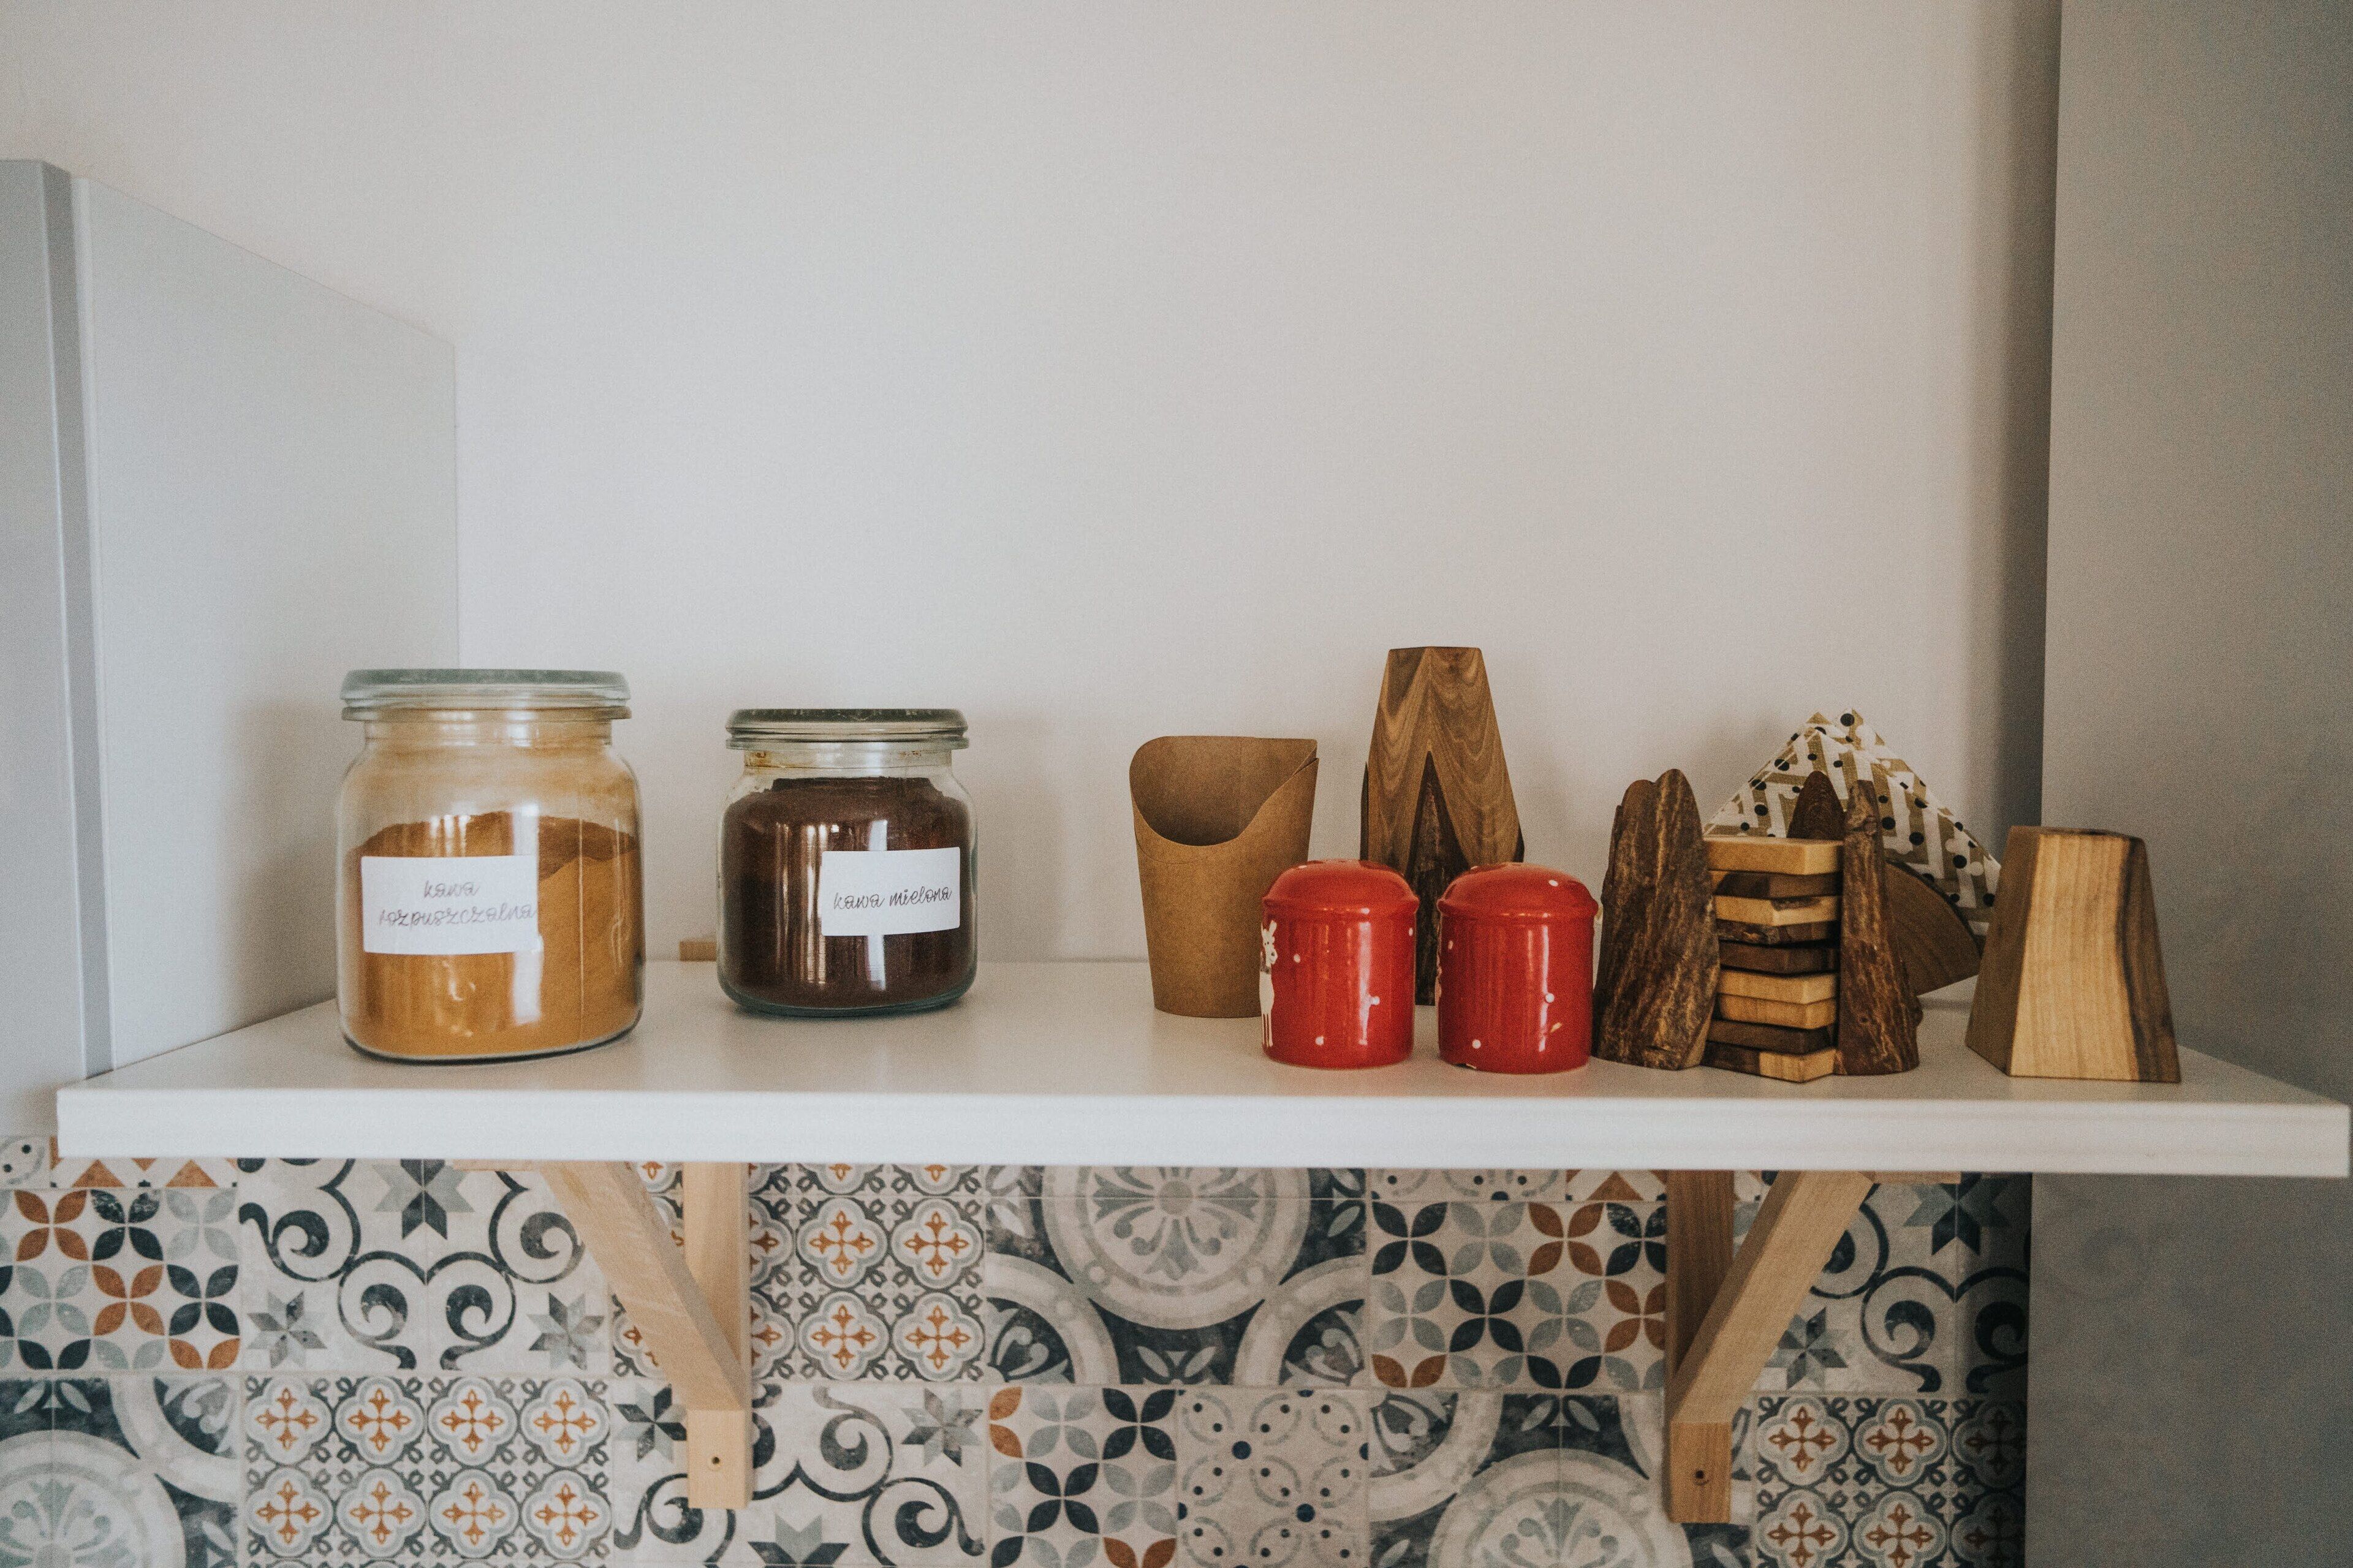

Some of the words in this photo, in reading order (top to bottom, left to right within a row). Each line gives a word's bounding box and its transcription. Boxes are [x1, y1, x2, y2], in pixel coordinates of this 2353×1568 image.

[424, 881, 480, 898] kawa
[833, 892, 885, 910] kawa
[889, 886, 952, 907] mielona
[379, 903, 536, 928] rozpuszczalna
